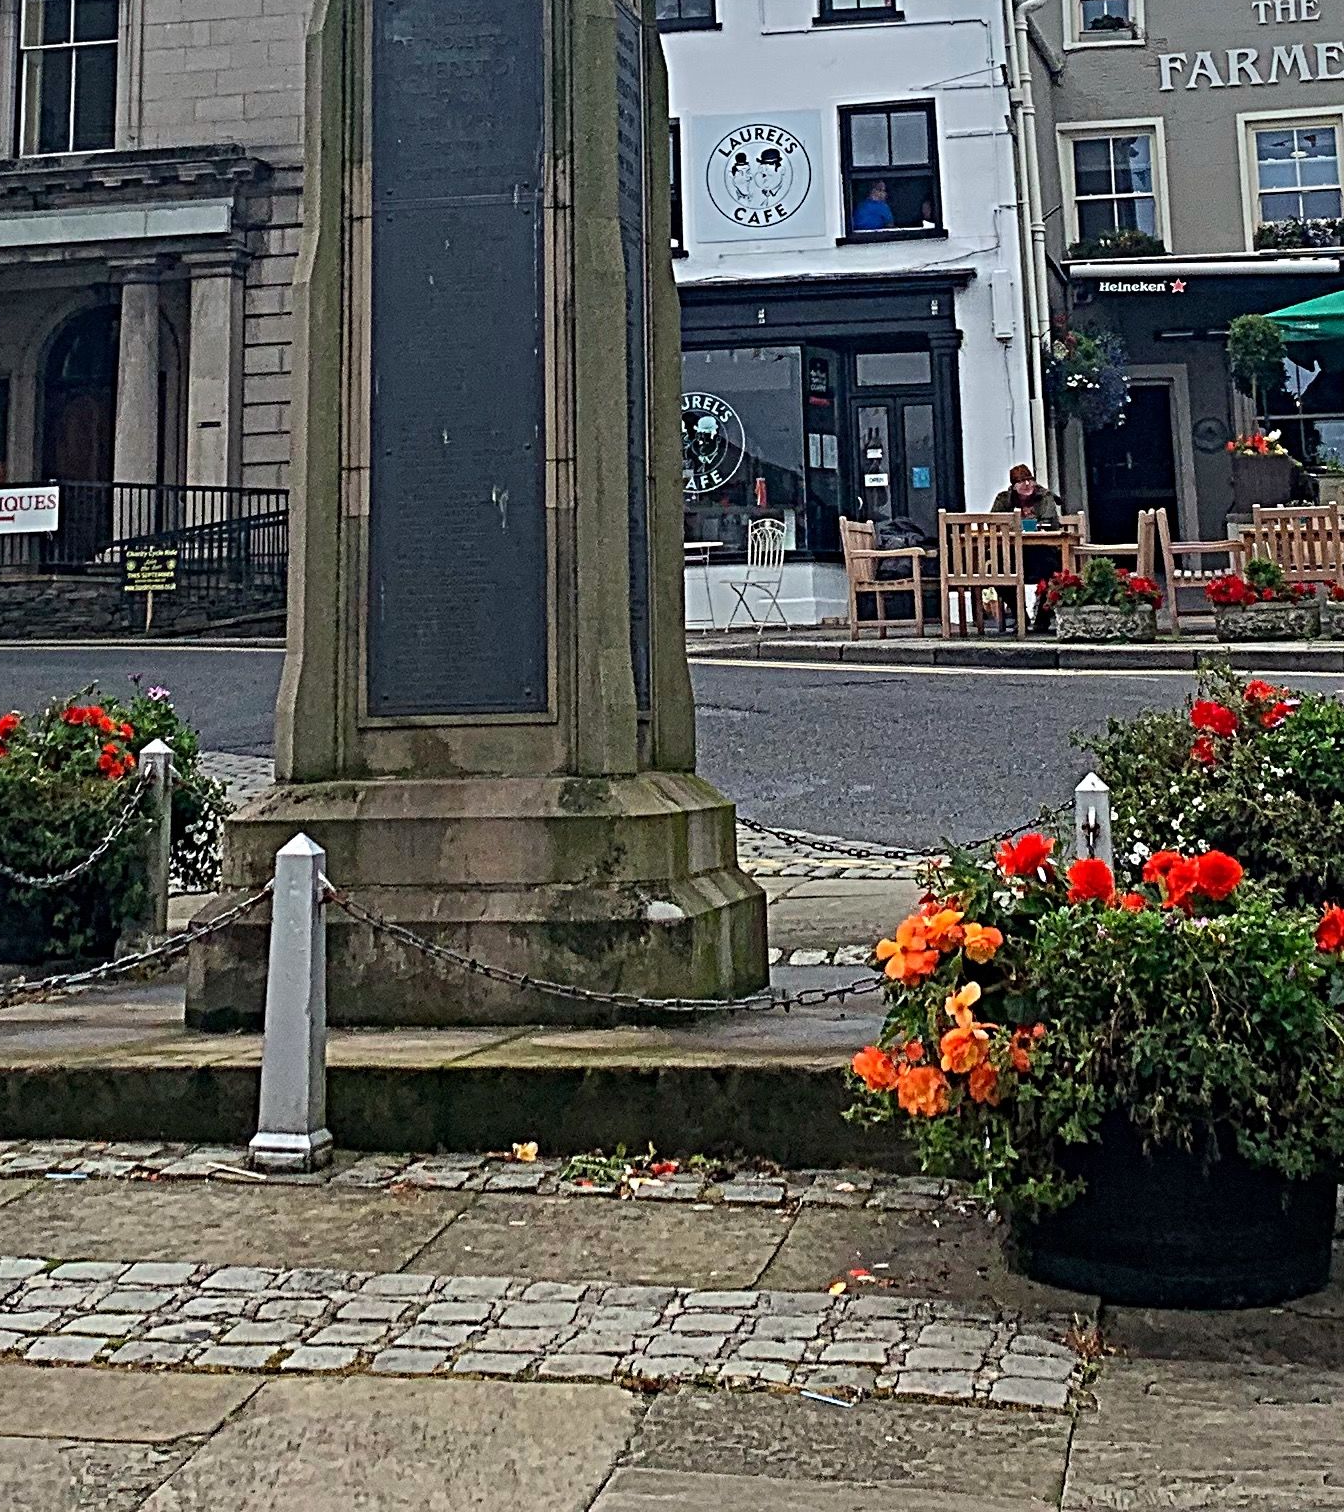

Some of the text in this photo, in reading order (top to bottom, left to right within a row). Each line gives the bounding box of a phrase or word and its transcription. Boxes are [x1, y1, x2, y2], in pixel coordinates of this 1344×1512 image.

[718, 127, 797, 158] LAUREL'S
[734, 204, 787, 224] CAFE
[1099, 281, 1166, 292] Heineken
[681, 396, 733, 423] UREL'S
[686, 470, 723, 489] AFE
